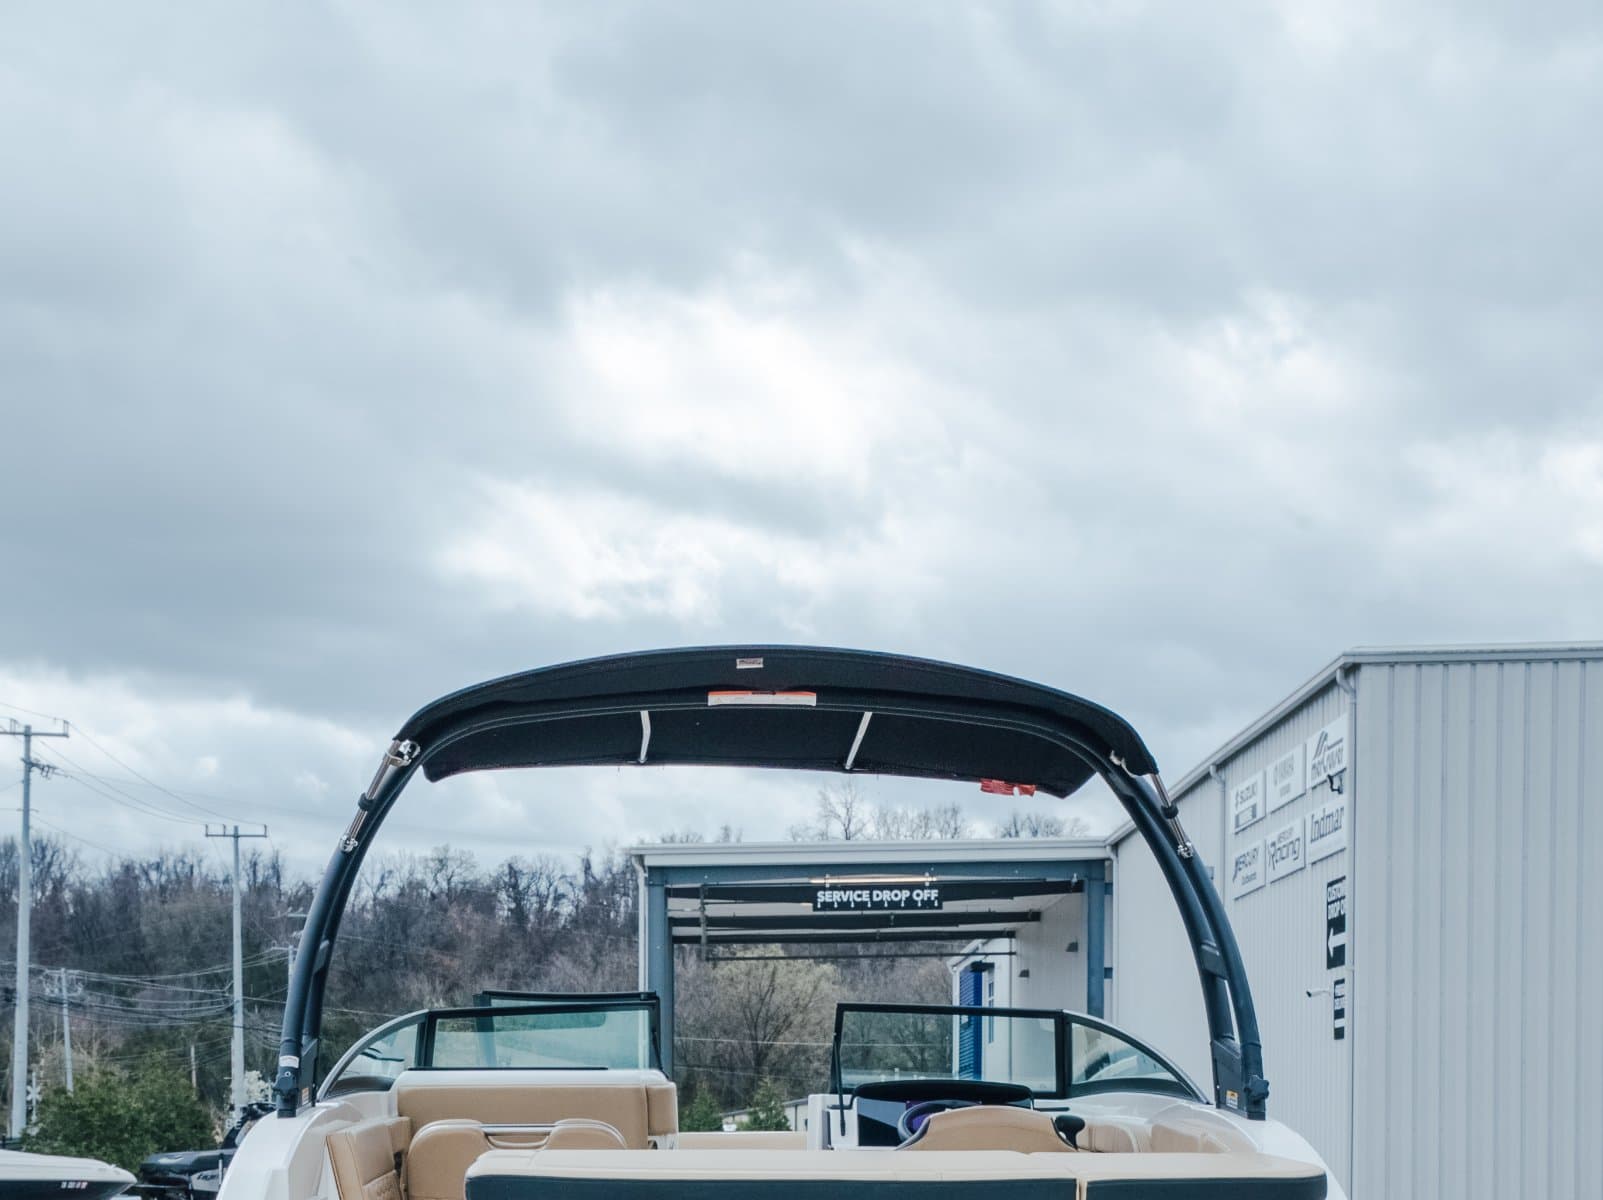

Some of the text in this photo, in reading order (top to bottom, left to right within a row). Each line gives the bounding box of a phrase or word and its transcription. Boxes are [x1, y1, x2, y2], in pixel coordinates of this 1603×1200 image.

[1310, 806, 1344, 843] Indmar
[817, 889, 939, 902] SERVICE DROP OFF
